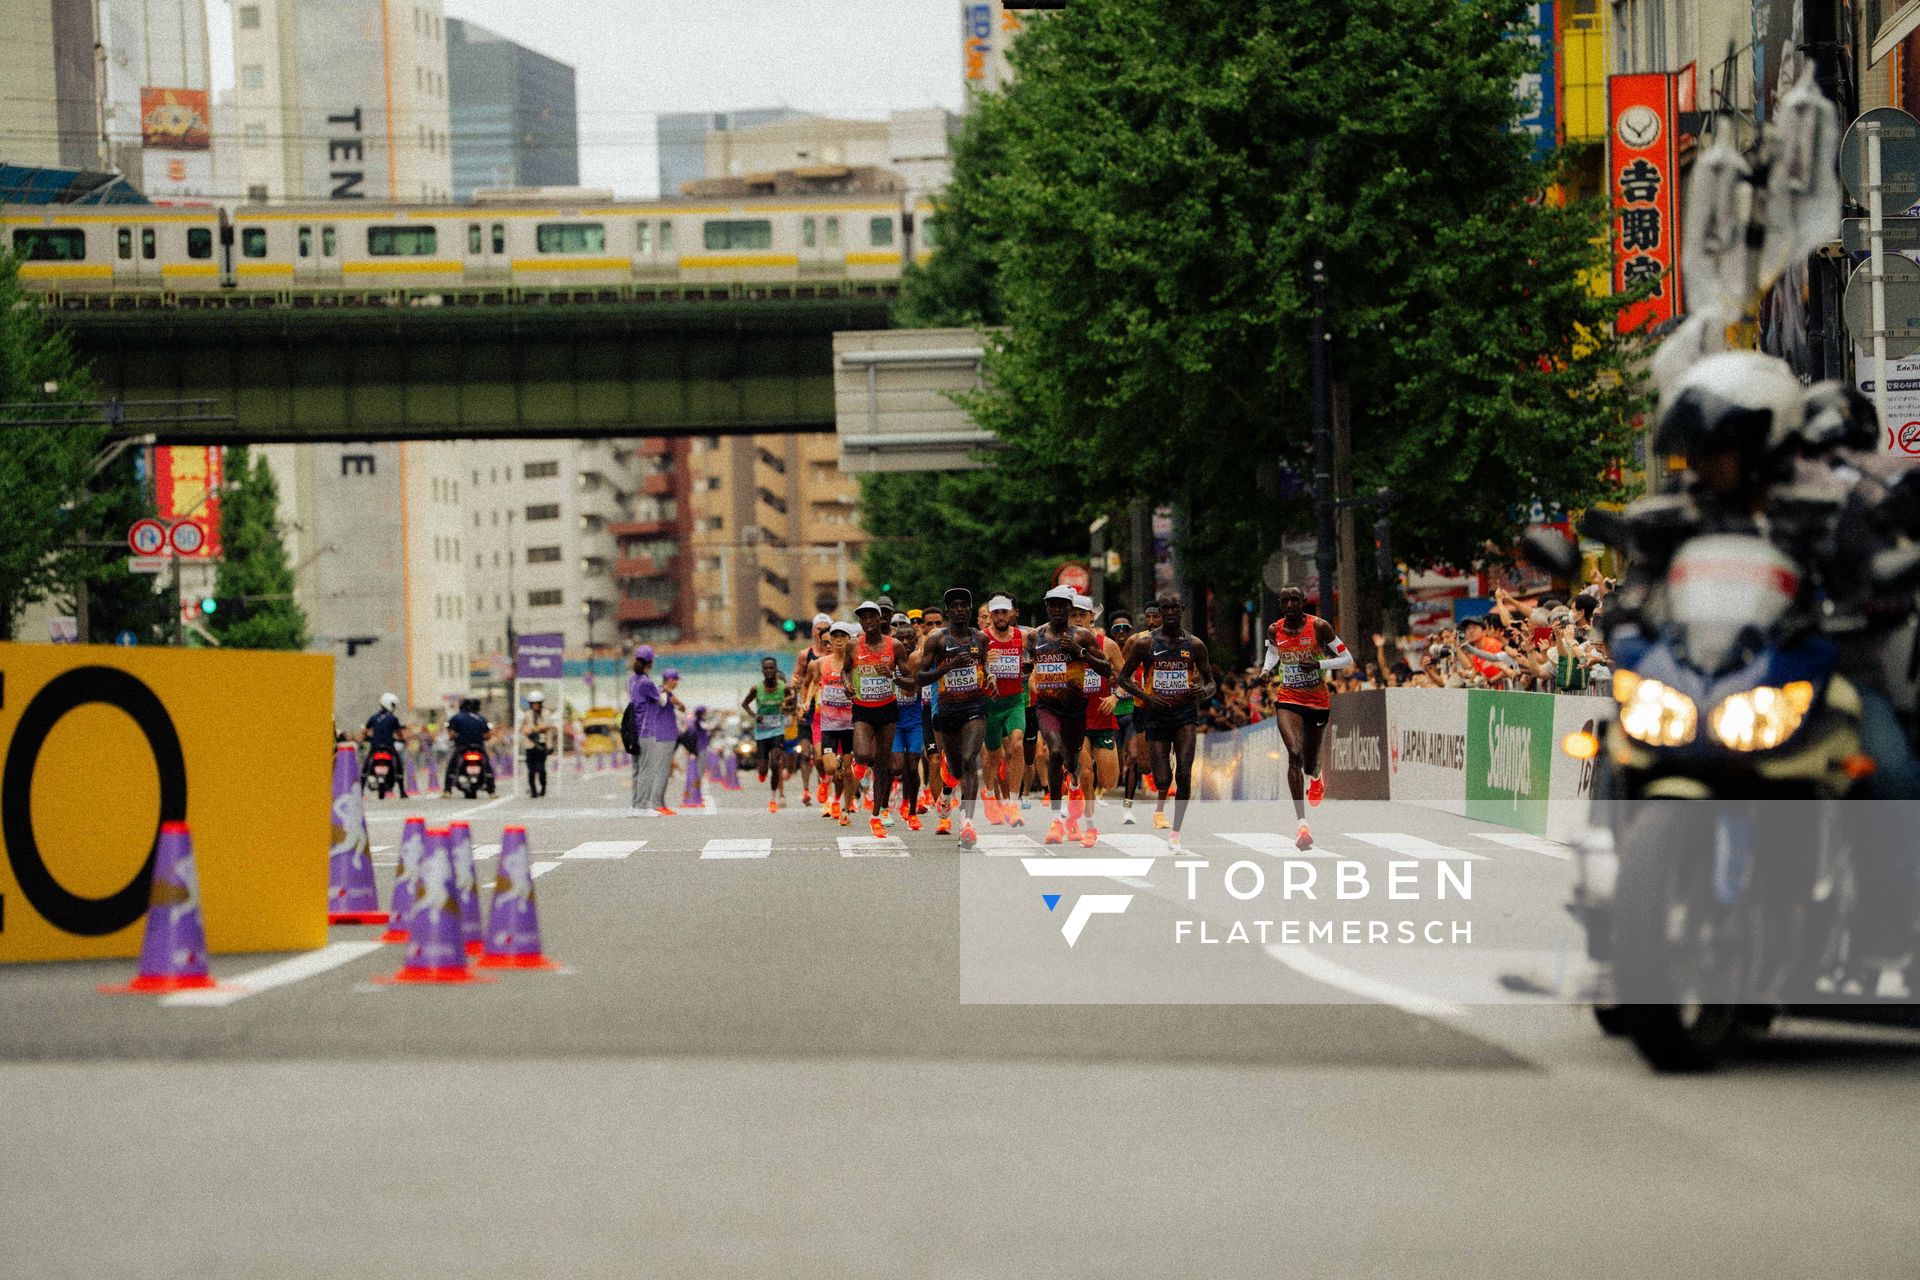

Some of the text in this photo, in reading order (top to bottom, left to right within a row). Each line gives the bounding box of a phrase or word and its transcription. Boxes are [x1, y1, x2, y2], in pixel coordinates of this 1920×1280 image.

[328, 107, 363, 199] TEN
[1036, 653, 1072, 662] UGANDA
[858, 664, 879, 674] KEN
[1040, 664, 1063, 672] TDK
[1154, 661, 1188, 669] UGANDA
[952, 668, 975, 677] TDK
[1164, 671, 1186, 679] TDK
[869, 677, 889, 685] TDK
[948, 677, 975, 686] KISSA
[1402, 730, 1465, 770] JAPAN AIRLINES
